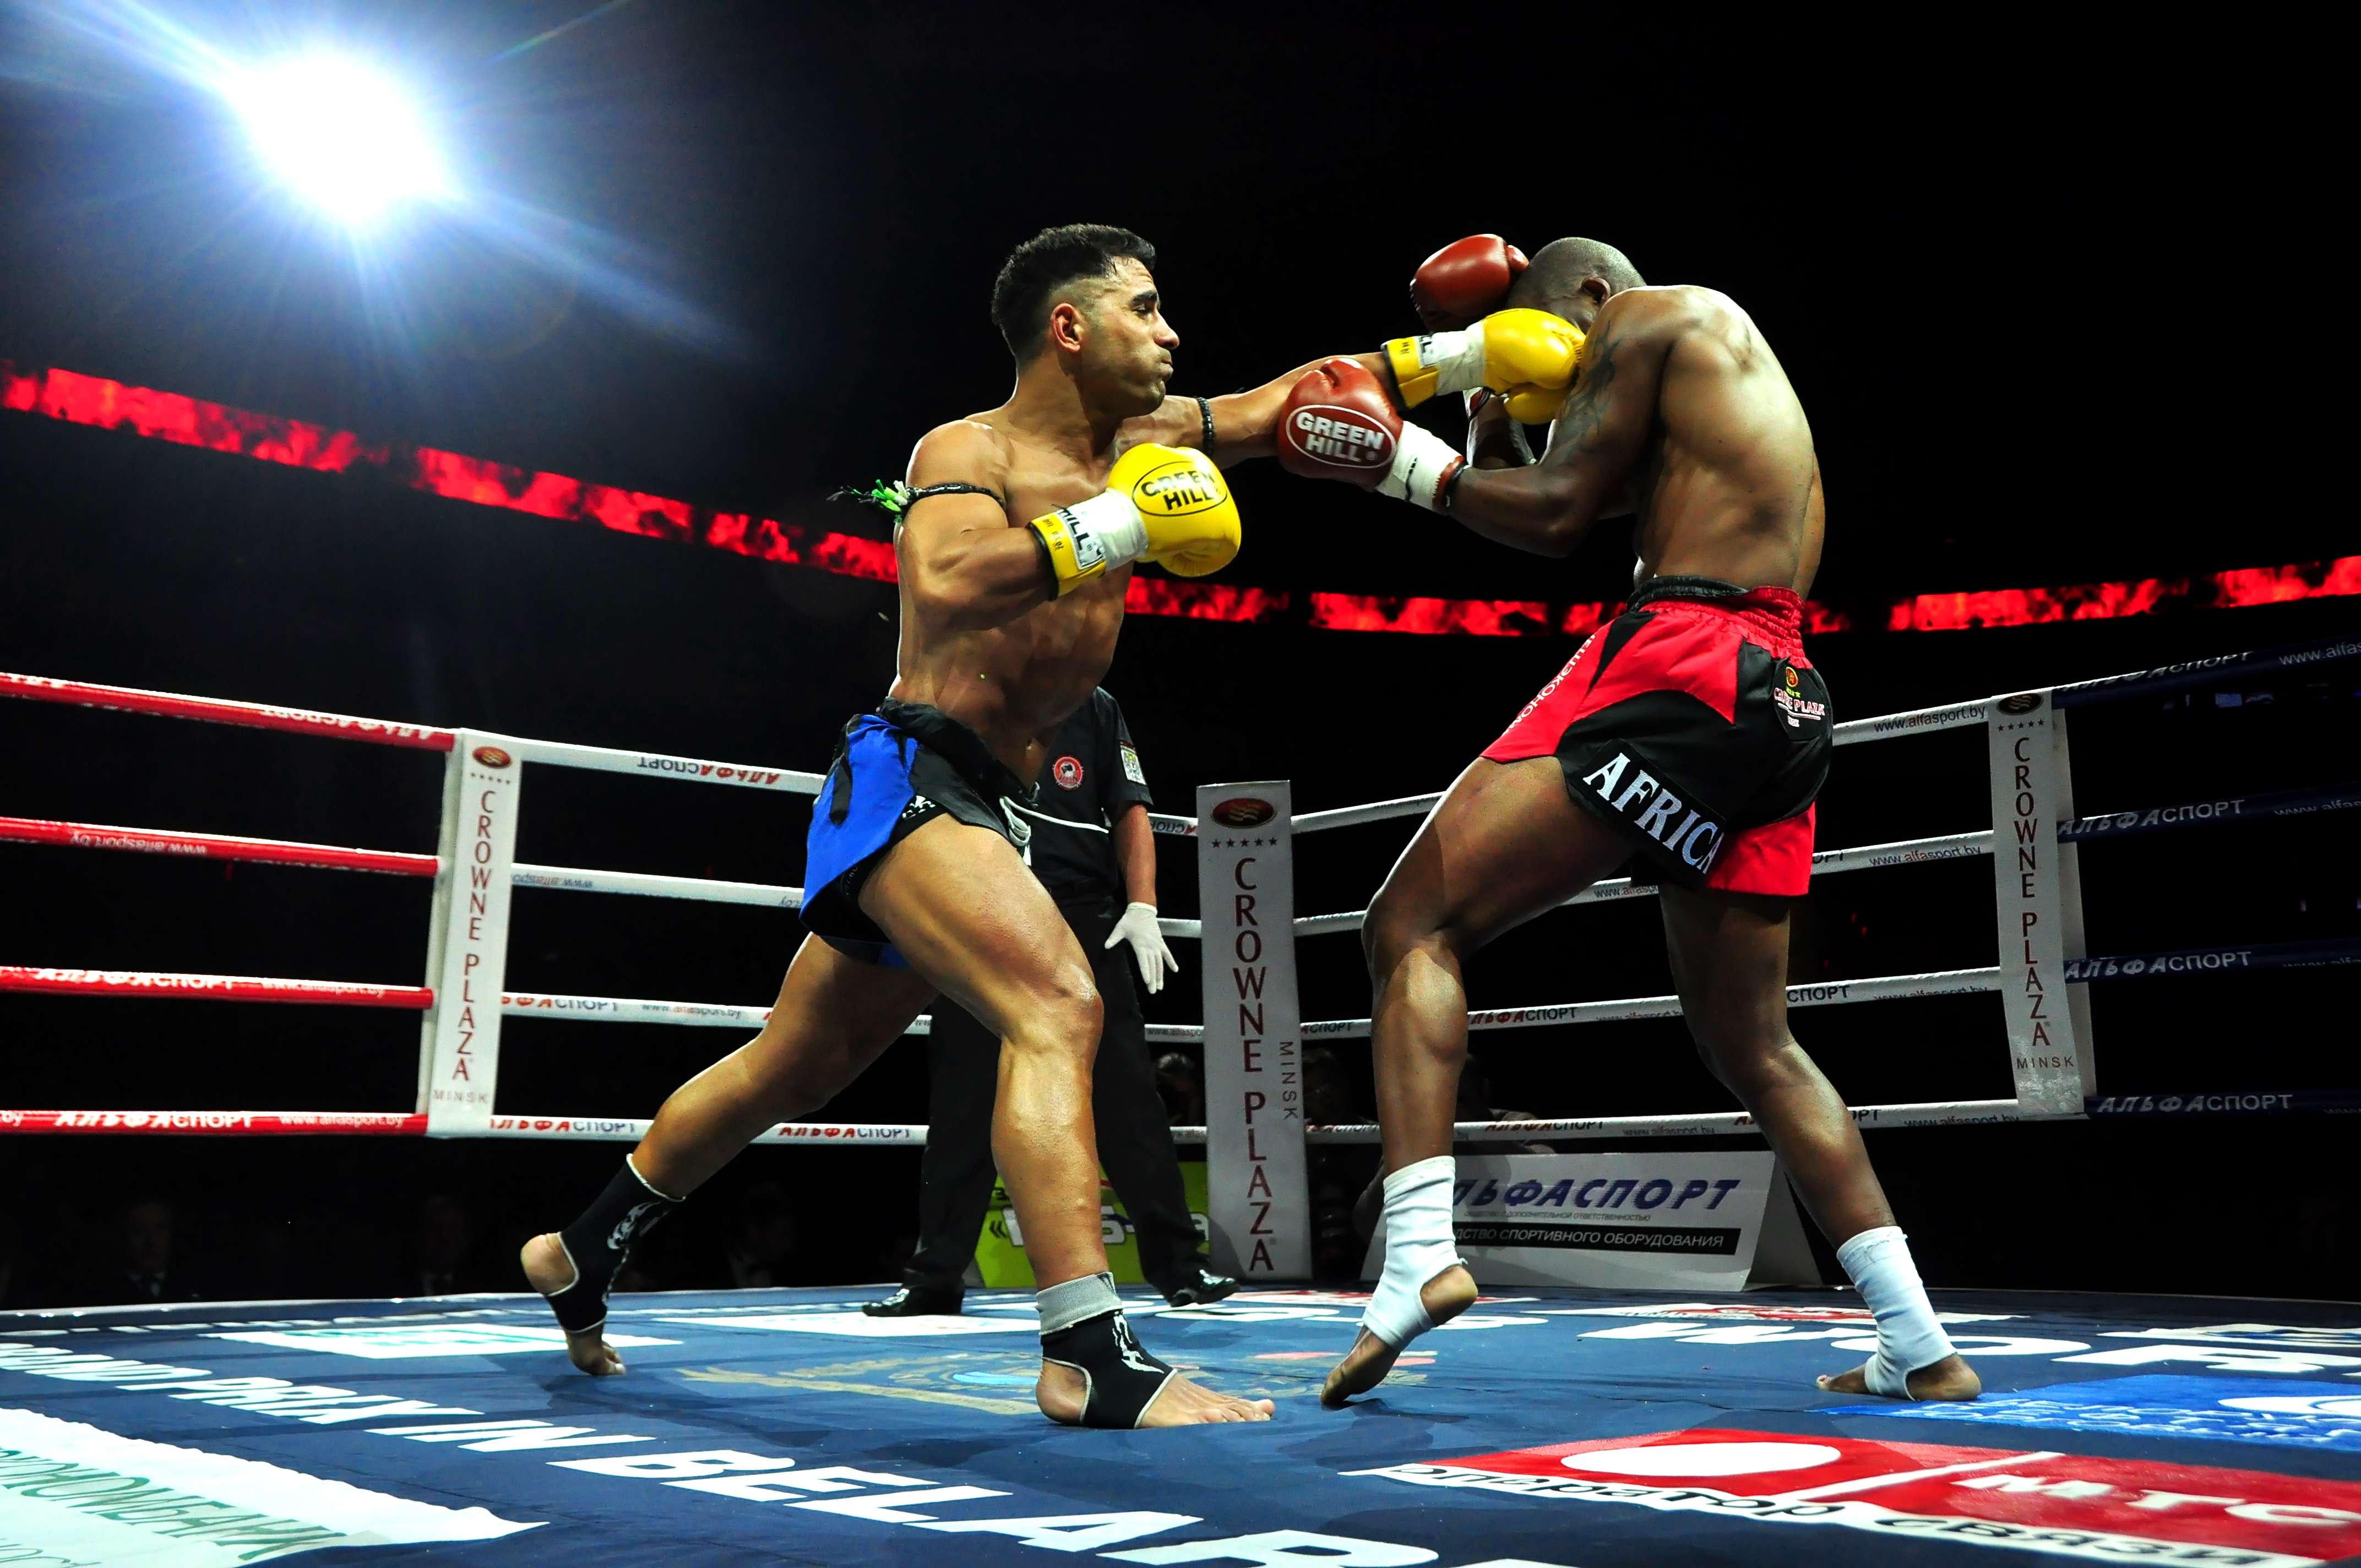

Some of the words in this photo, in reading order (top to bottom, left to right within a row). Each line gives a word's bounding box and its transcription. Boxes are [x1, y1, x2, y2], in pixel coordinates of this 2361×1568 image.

[1296, 412, 1385, 450] GREEN
[1305, 433, 1362, 462] HILL
[1163, 486, 1214, 511] HILL
[1794, 699, 1825, 716] PLAZA
[1874, 706, 1985, 732] www.alfasport.by
[637, 756, 781, 785] АЛЬФАСПОРТ
[1583, 752, 1724, 874] AFRICA
[2014, 737, 2038, 899] CROWNE
[2058, 799, 2245, 835] АЛЬФАСПОРТ
[469, 791, 496, 941] CROWNE
[1232, 857, 1266, 1072] CROWNE
[2022, 912, 2050, 1047] PLAZA
[2065, 951, 2252, 979] АЛЬФАСПОРТ
[453, 954, 480, 1081] PLAZA
[1470, 1006, 1578, 1025] ЛЬФАСПОРТ
[2016, 1055, 2075, 1070] MINSK
[433, 1089, 488, 1103] MINSK
[1279, 1041, 1298, 1120] MINSK
[2097, 1093, 2293, 1113] АЛЬФАСПОРТ
[1245, 1092, 1274, 1271] PLAZA
[1452, 1179, 1742, 1211] ЛЬФАСПОРТ
[1453, 1228, 1497, 1240] ДСТВО
[1499, 1229, 1600, 1244] СПОРТИВНОГО
[1603, 1232, 1724, 1248] ОБОРУДОВАНИЯ
[1577, 1322, 2361, 1376] WOR
[115, 1376, 485, 1424] PRIX
[363, 1419, 656, 1452] IN
[546, 1449, 1580, 1568] BELAR
